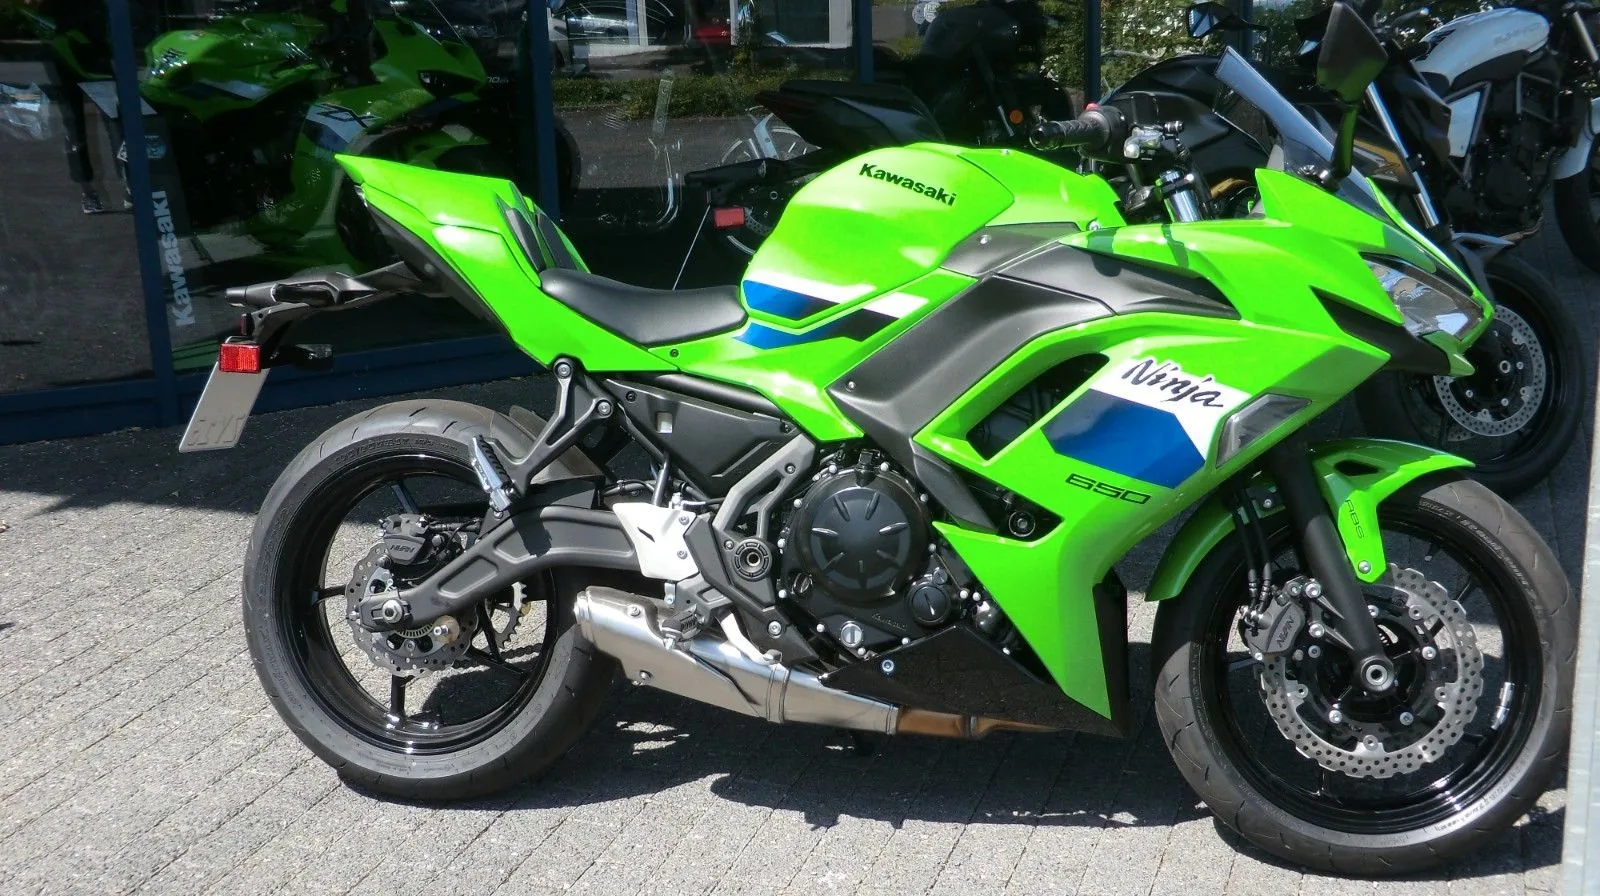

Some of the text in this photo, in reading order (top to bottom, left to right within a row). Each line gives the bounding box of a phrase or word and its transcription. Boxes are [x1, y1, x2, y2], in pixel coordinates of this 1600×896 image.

[859, 163, 957, 206] Kawasaki
[152, 190, 196, 327] Kawasaki
[1121, 359, 1224, 407] Ninja
[1065, 473, 1151, 504] 650
[1345, 499, 1364, 539] ABS
